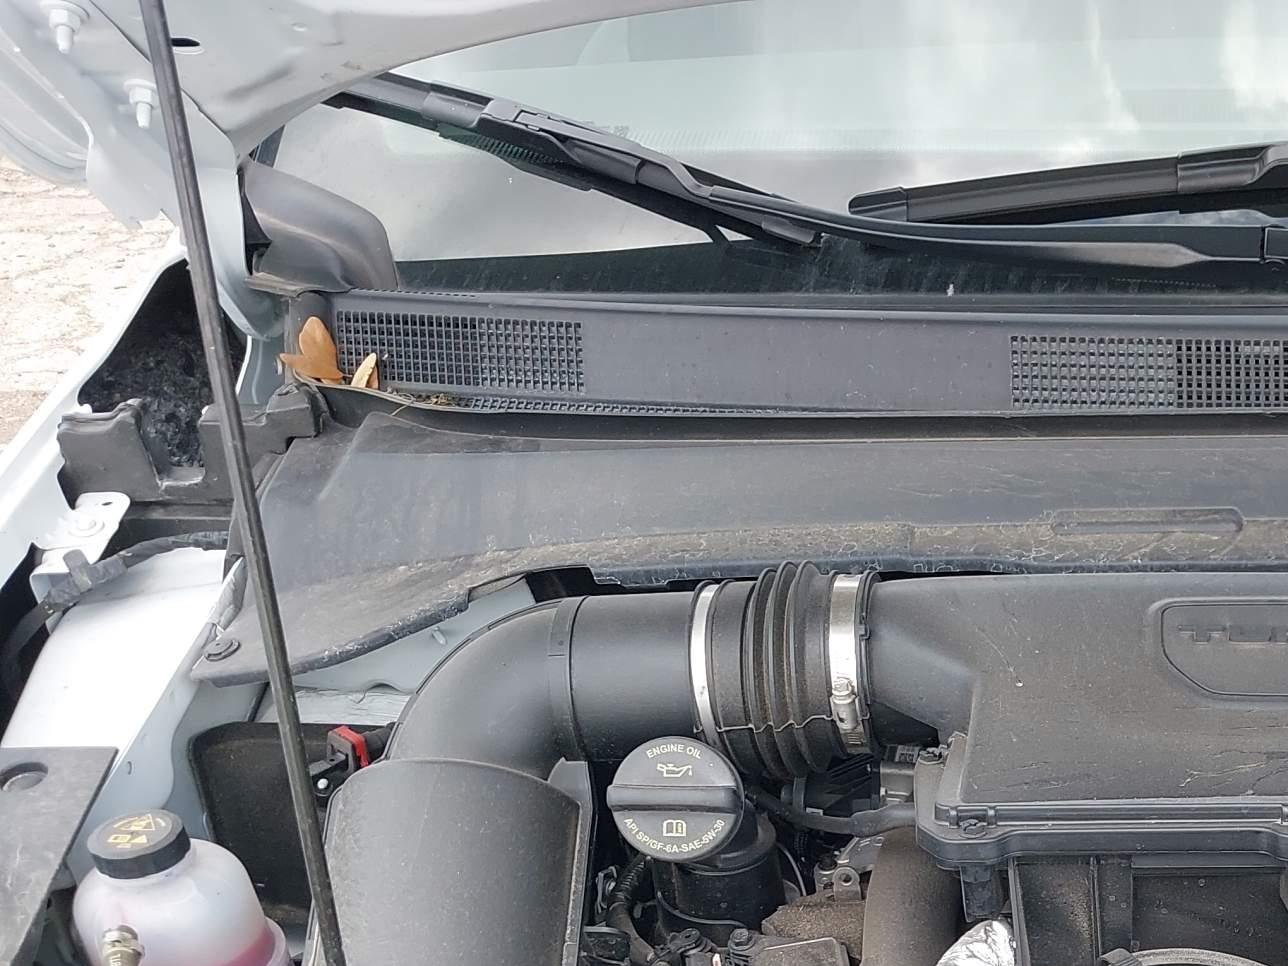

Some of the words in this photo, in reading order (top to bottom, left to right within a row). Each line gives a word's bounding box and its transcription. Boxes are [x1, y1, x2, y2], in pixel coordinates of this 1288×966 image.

[646, 744, 685, 759] ENGINE
[686, 746, 704, 760] OIL
[624, 819, 638, 836] API
